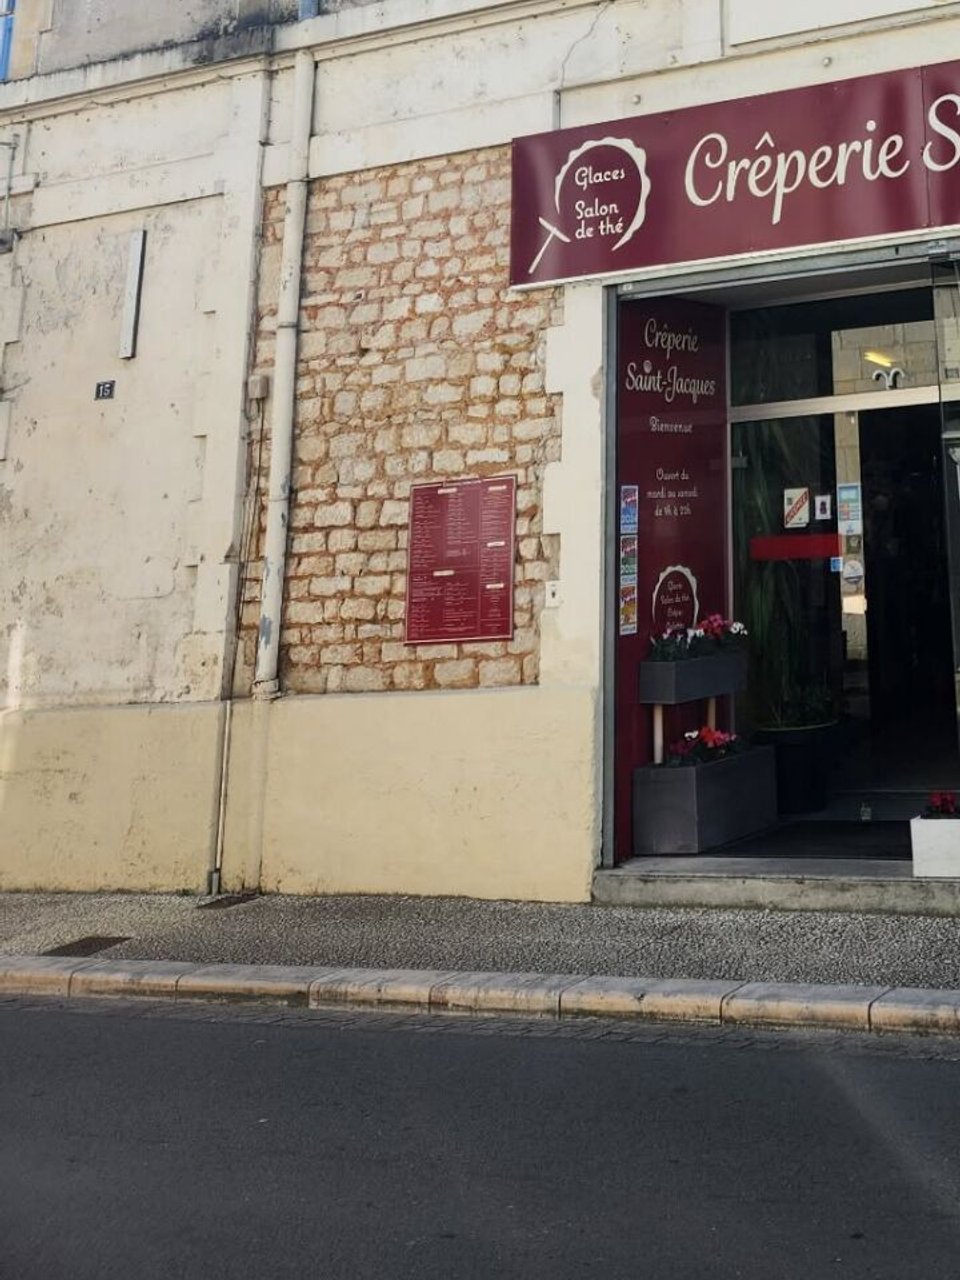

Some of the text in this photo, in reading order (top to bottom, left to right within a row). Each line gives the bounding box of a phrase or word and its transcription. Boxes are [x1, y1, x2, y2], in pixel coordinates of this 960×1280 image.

[574, 166, 626, 191] Glaces
[684, 120, 910, 225] Crêperie
[574, 197, 620, 220] Salon
[574, 216, 624, 239] de thé
[644, 318, 699, 360] Crêperie
[625, 361, 716, 404] Saint-Jacques
[649, 416, 693, 434] Bienvenue
